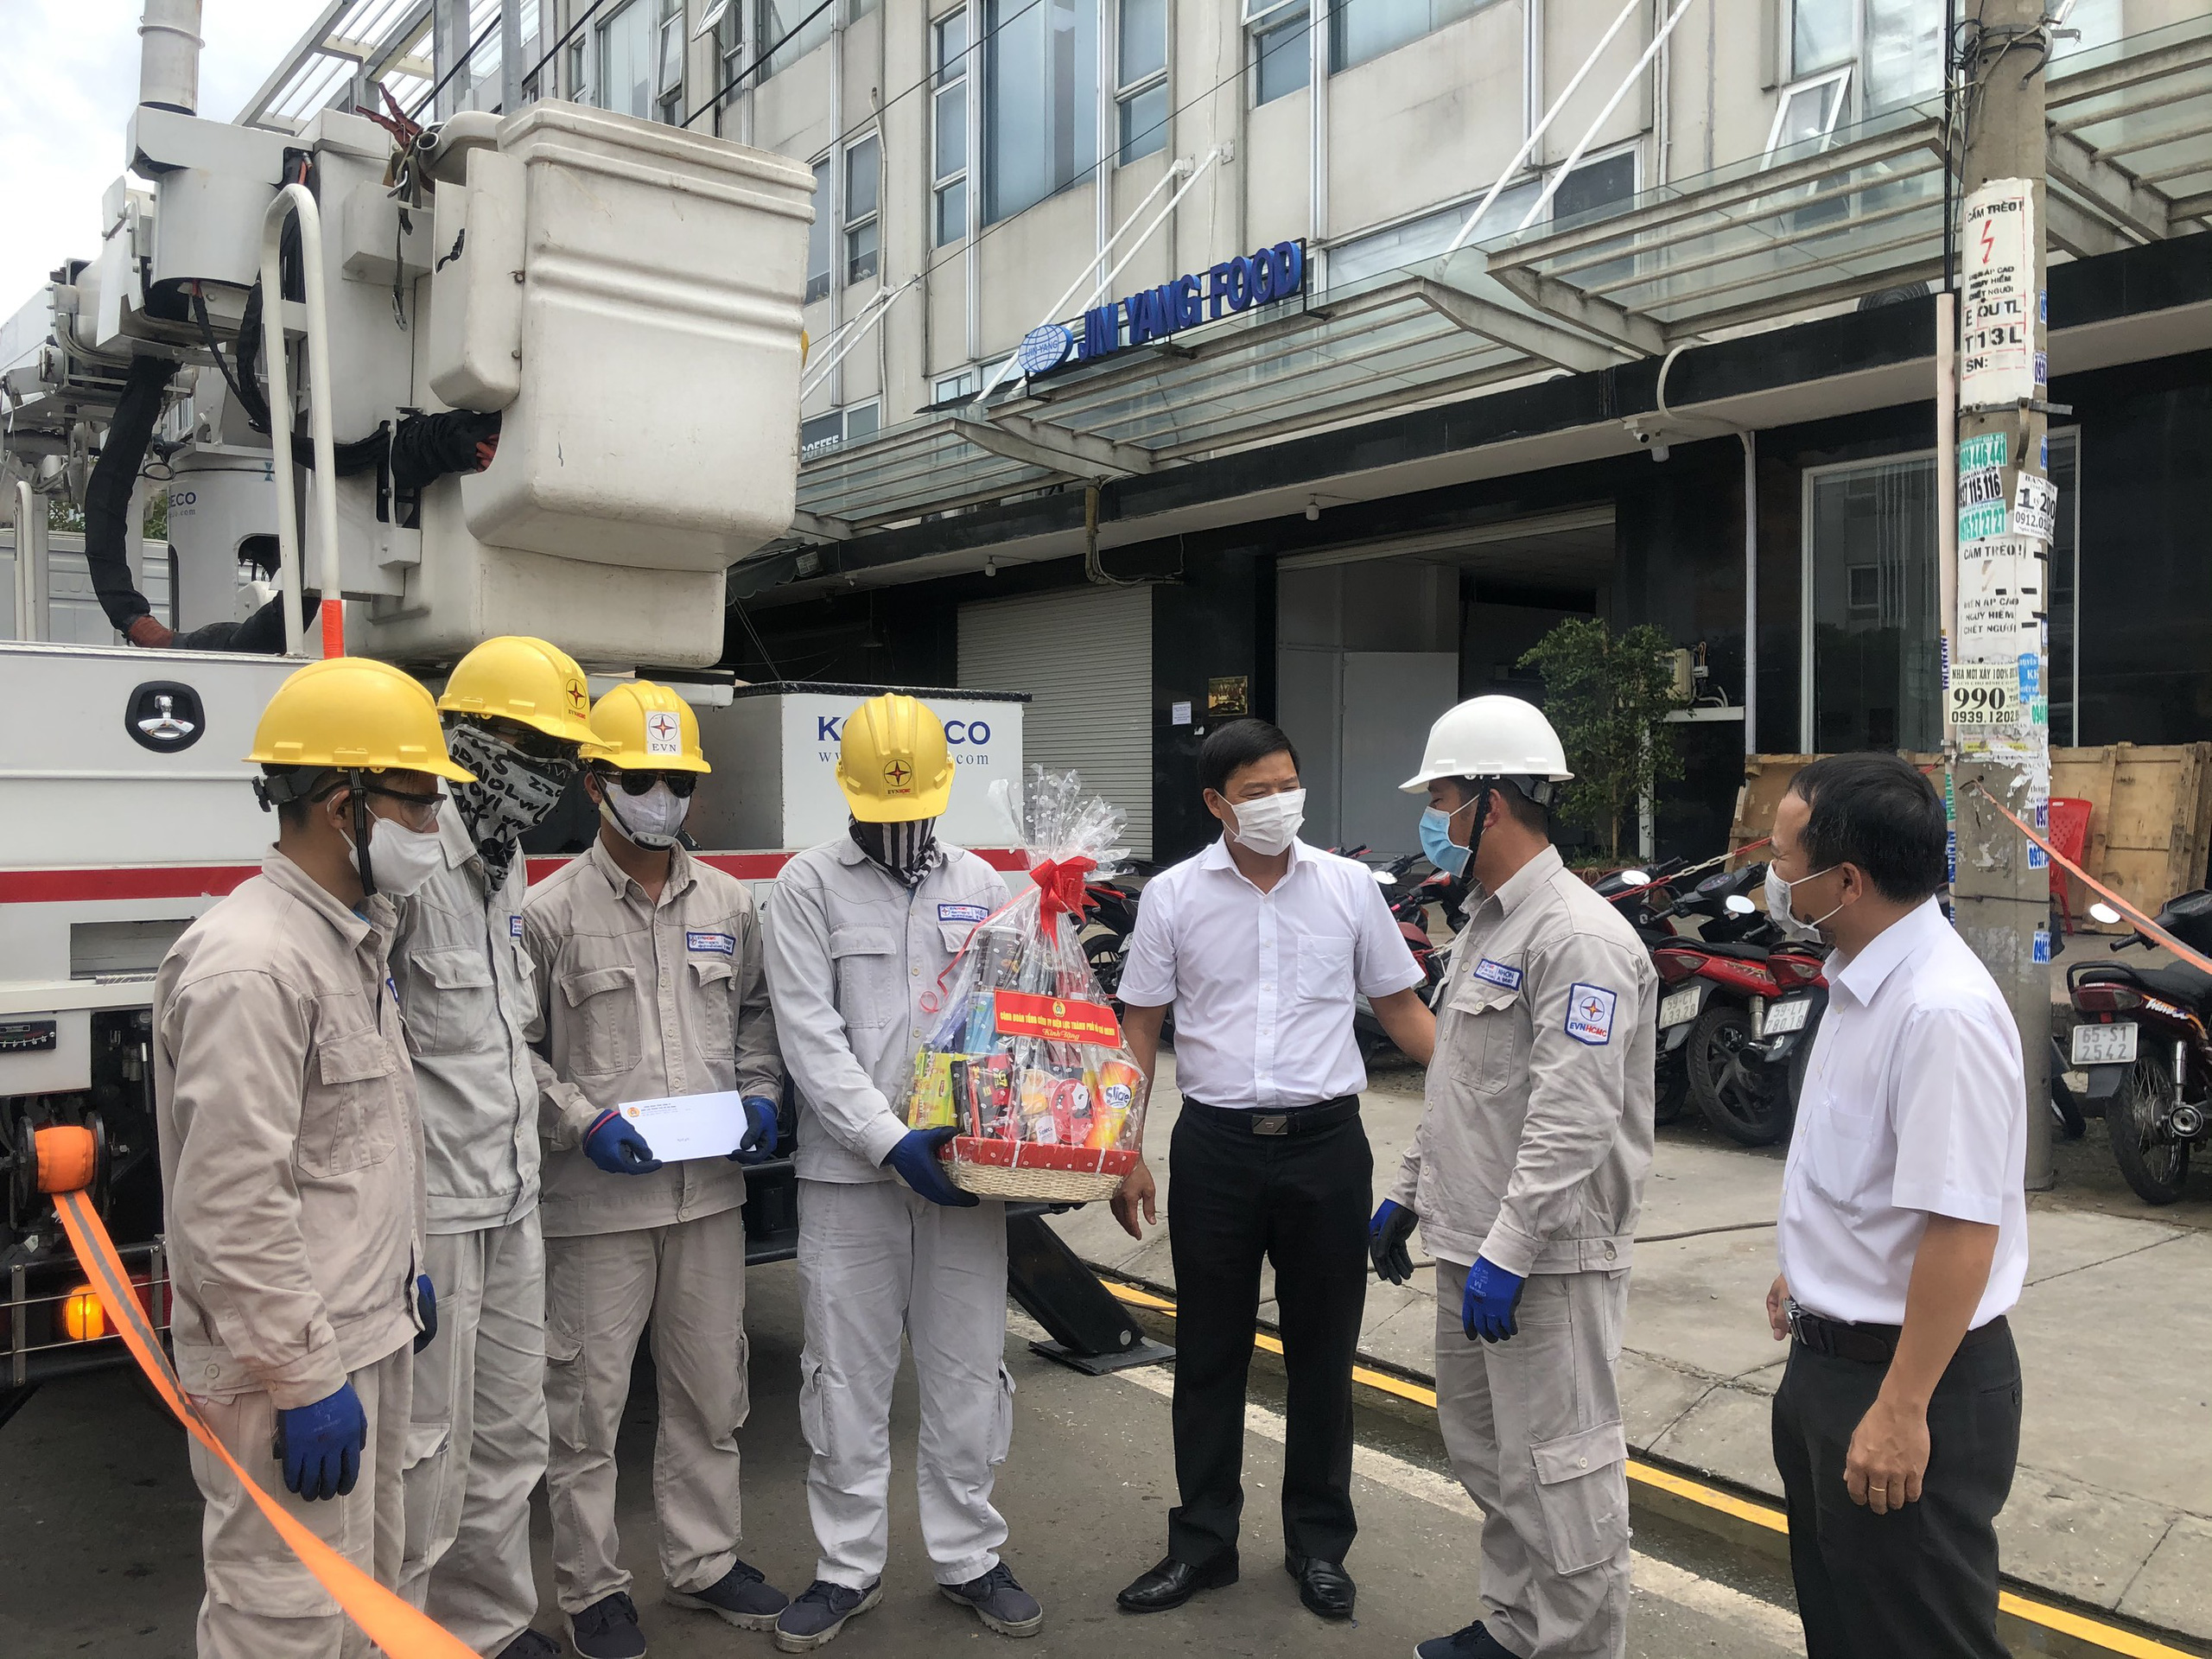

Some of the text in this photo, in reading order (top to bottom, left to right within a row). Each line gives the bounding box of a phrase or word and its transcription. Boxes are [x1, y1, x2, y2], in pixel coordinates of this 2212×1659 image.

[1077, 240, 1301, 362] JIN YANG FOOD
[1954, 687, 2005, 710] 990
[652, 743, 677, 752] EVN
[1569, 1021, 1607, 1038] EVNHCMC
[1764, 1014, 1804, 1033] 780.18
[2082, 1025, 2126, 1044] 65-S1
[2082, 1044, 2126, 1061] 2542
